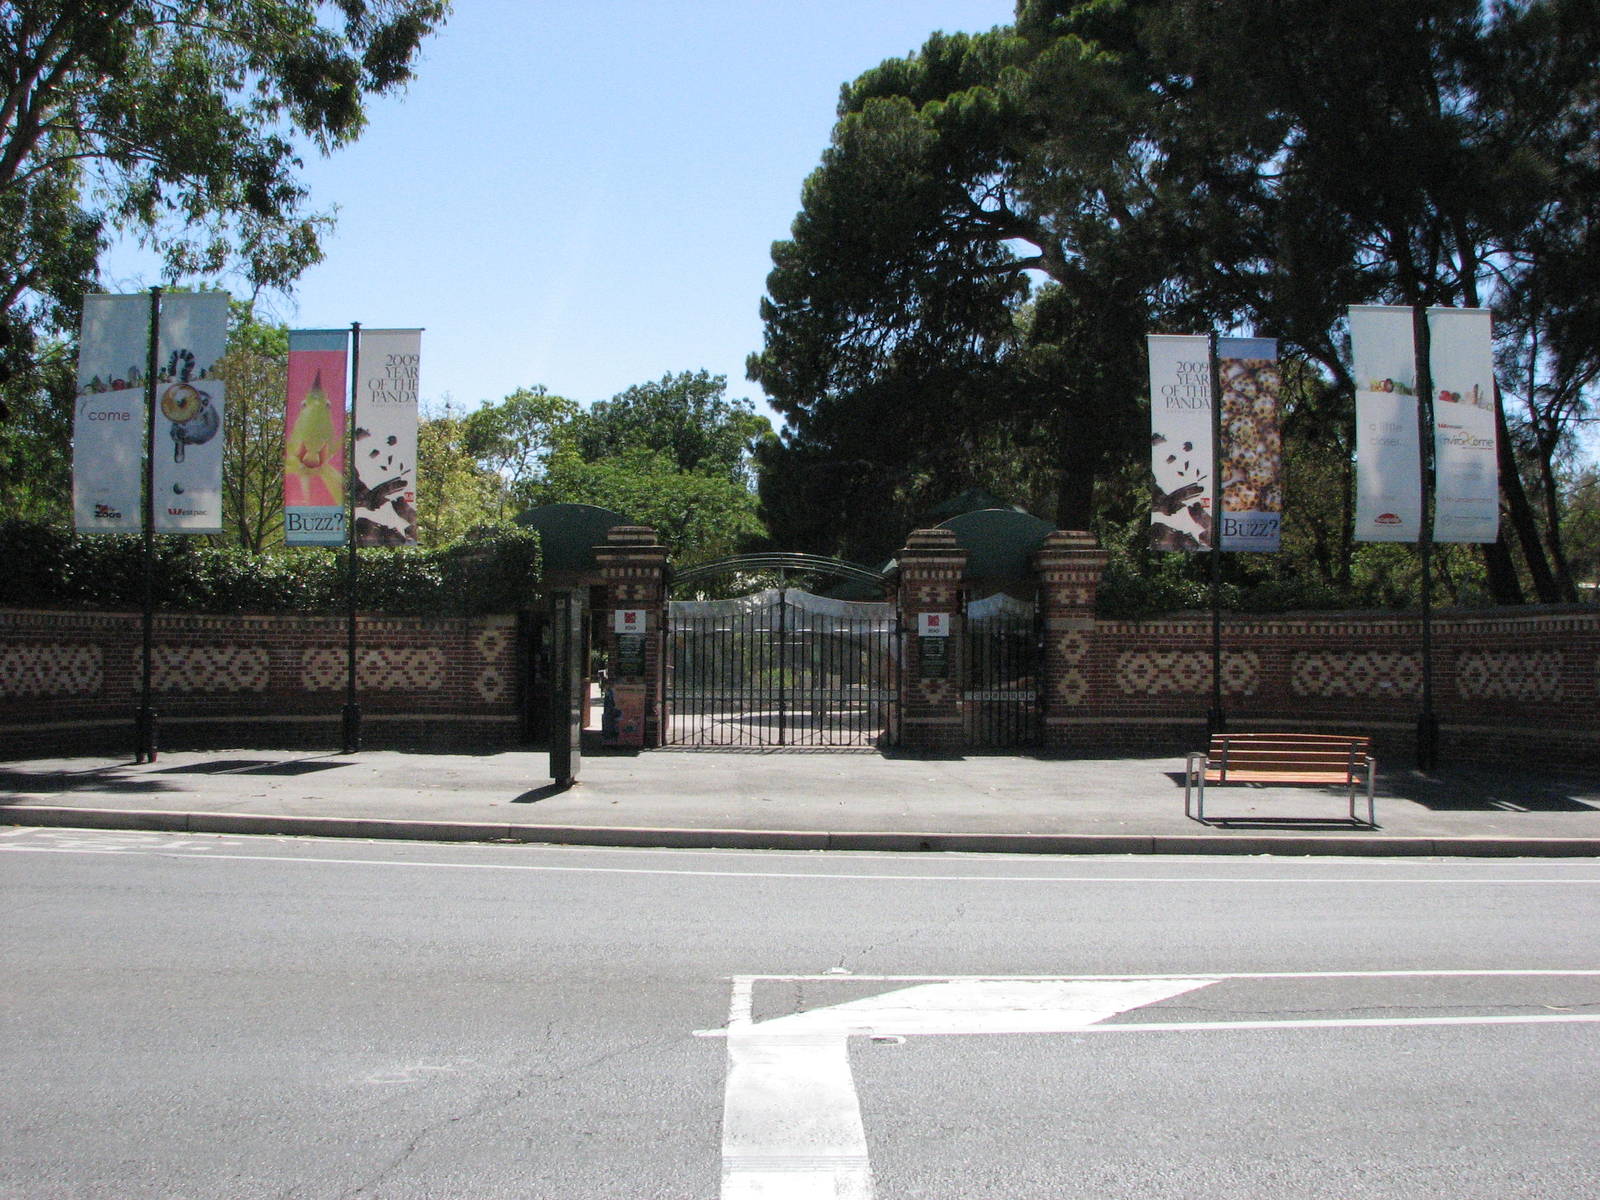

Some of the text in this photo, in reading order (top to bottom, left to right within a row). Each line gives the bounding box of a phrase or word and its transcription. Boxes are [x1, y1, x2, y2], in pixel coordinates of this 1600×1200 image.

[385, 354, 420, 367] 2009
[385, 367, 419, 379] YEAR
[1176, 361, 1209, 374] 2009
[368, 378, 419, 391] OF THE
[1176, 373, 1209, 385] YEAR
[371, 391, 418, 403] PANDA
[1161, 385, 1210, 398] OF THE
[1166, 397, 1211, 409] PANDA
[88, 411, 130, 421] come
